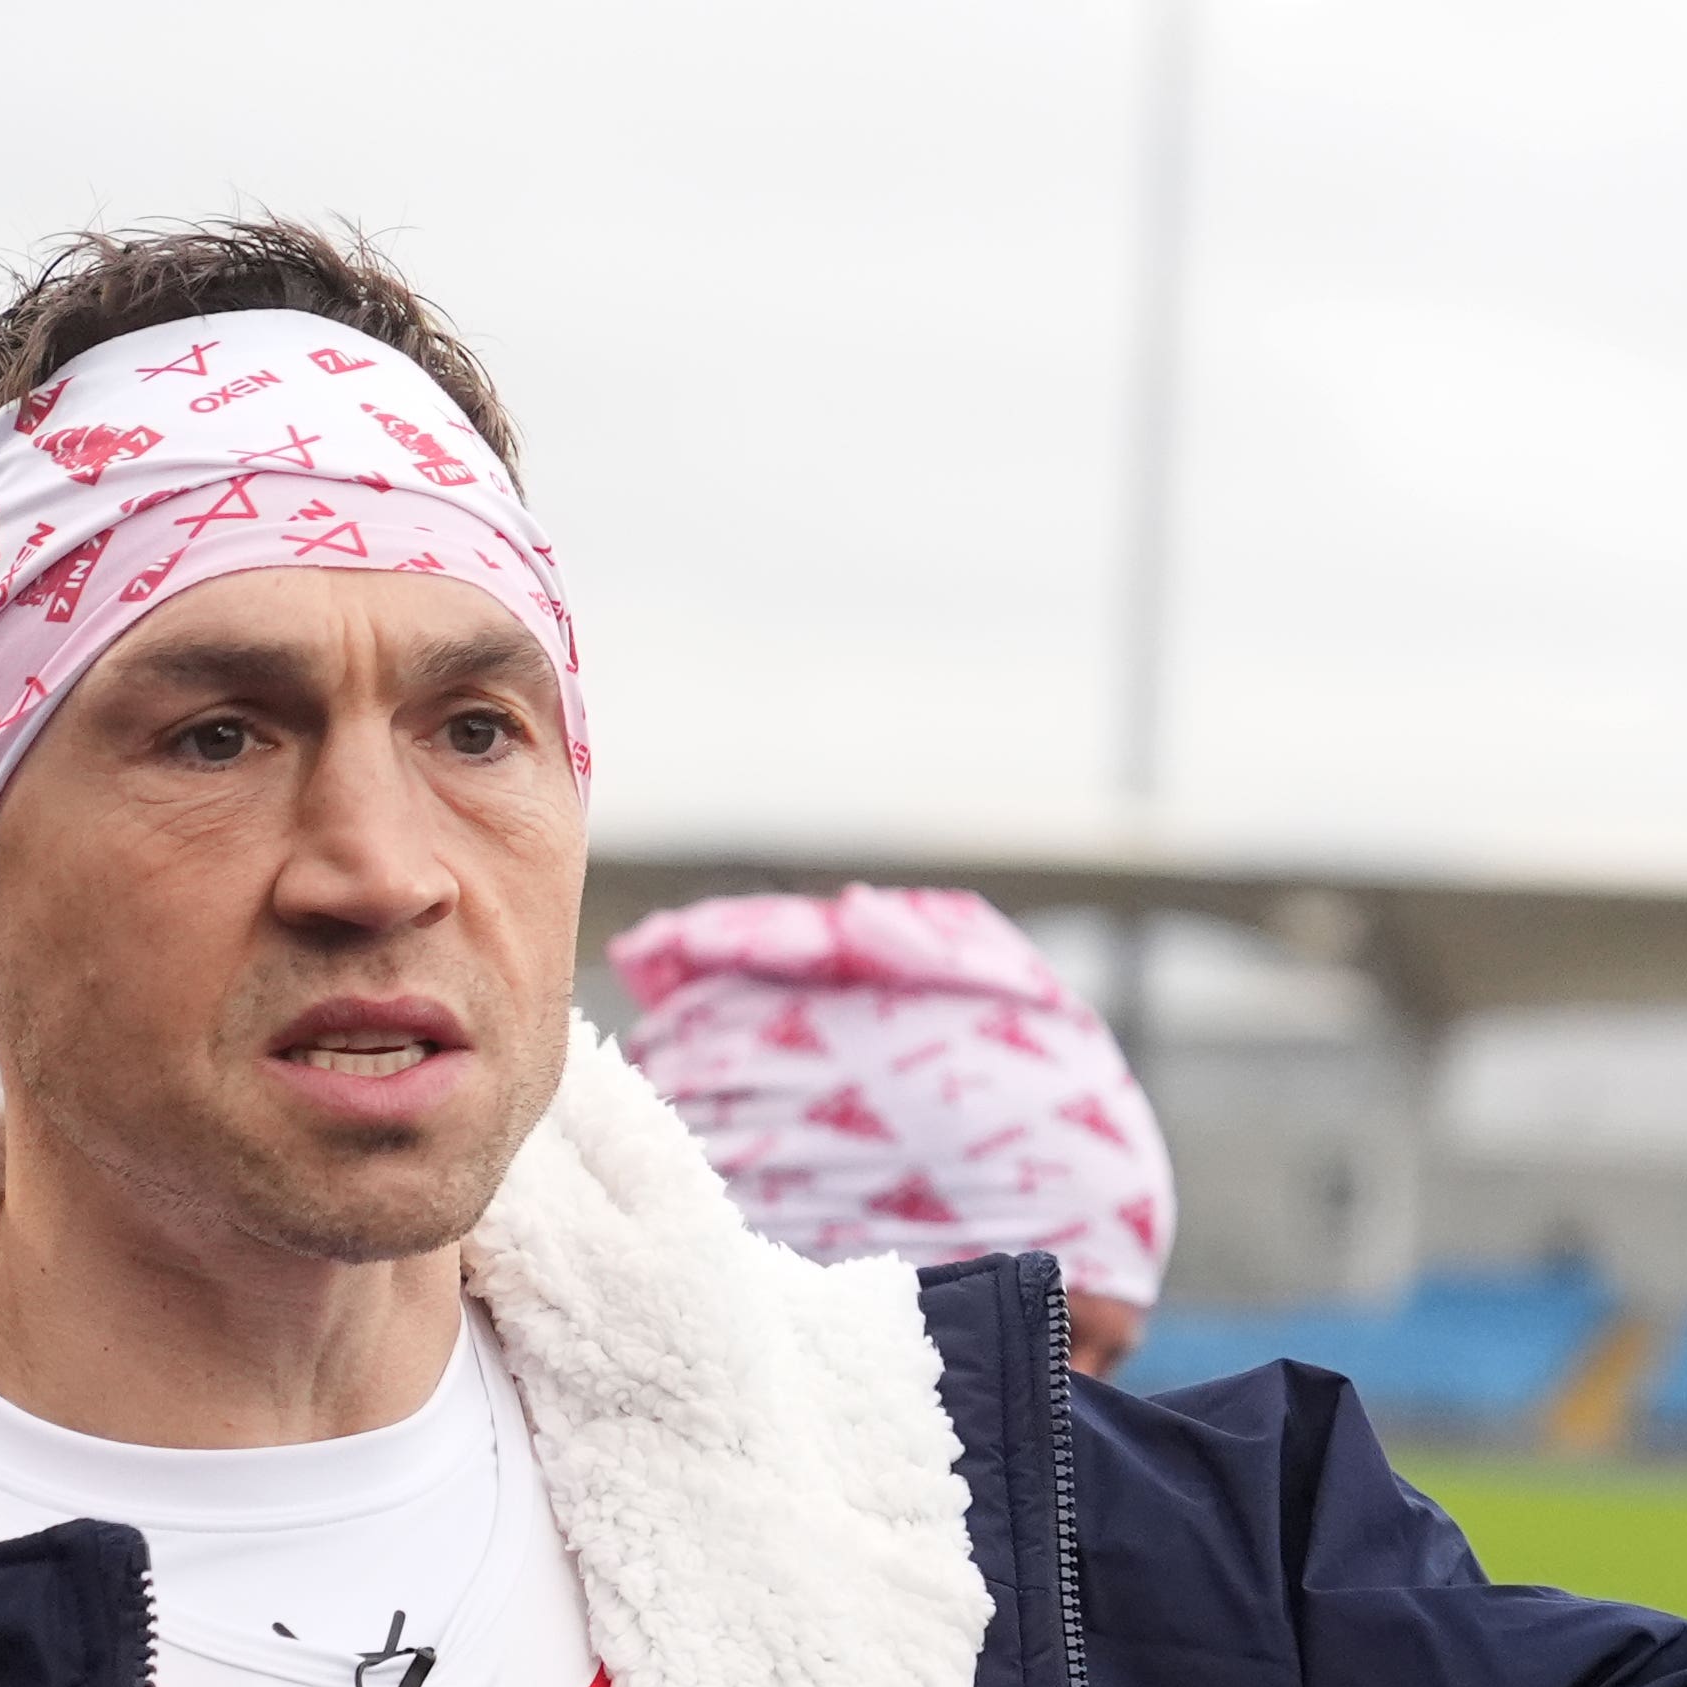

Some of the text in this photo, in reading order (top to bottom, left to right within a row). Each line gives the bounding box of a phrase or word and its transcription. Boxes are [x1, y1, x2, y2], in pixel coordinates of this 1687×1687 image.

[189, 369, 283, 413] OXEN
[422, 466, 442, 483] 7
[53, 597, 70, 614] 7
[64, 559, 93, 589] IN
[129, 578, 151, 595] 7
